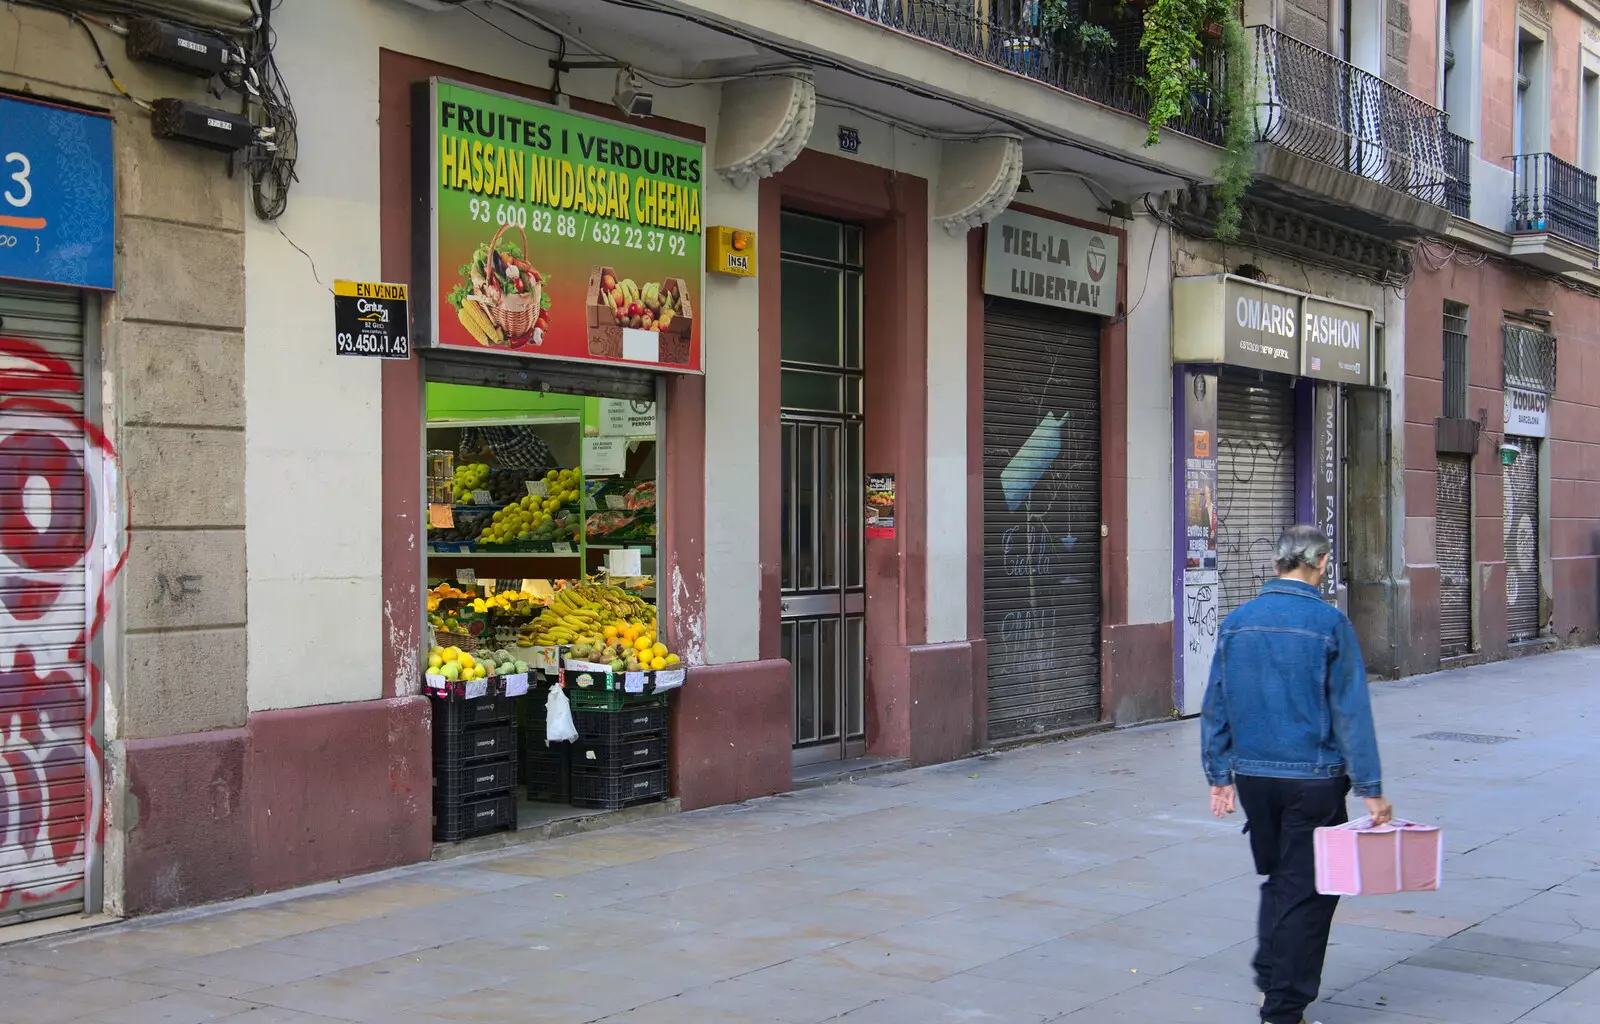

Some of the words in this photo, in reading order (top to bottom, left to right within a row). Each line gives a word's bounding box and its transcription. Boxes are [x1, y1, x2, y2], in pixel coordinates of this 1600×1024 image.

[441, 101, 552, 150] FRUITES
[561, 129, 568, 155] I
[576, 132, 701, 183] VERDURES
[4, 152, 32, 207] 3
[442, 134, 524, 201] HASSAN
[531, 154, 630, 222] MUDASSAR
[635, 176, 701, 236] CHEEMA
[469, 198, 490, 223] 93
[496, 203, 527, 229] 600
[532, 210, 552, 233] 82
[557, 215, 576, 238] 88
[580, 219, 588, 242] /
[593, 221, 620, 245] 632
[625, 227, 643, 249] 22
[647, 231, 664, 253] 37
[669, 235, 686, 257] 92
[728, 254, 748, 270] INSA
[357, 283, 371, 297] EN
[374, 284, 405, 300] VENDA
[1236, 297, 1295, 338] OMARIS
[1305, 313, 1360, 350] FASHION
[1513, 390, 1546, 413] ZODIACO
[1325, 394, 1335, 484] OMARIS
